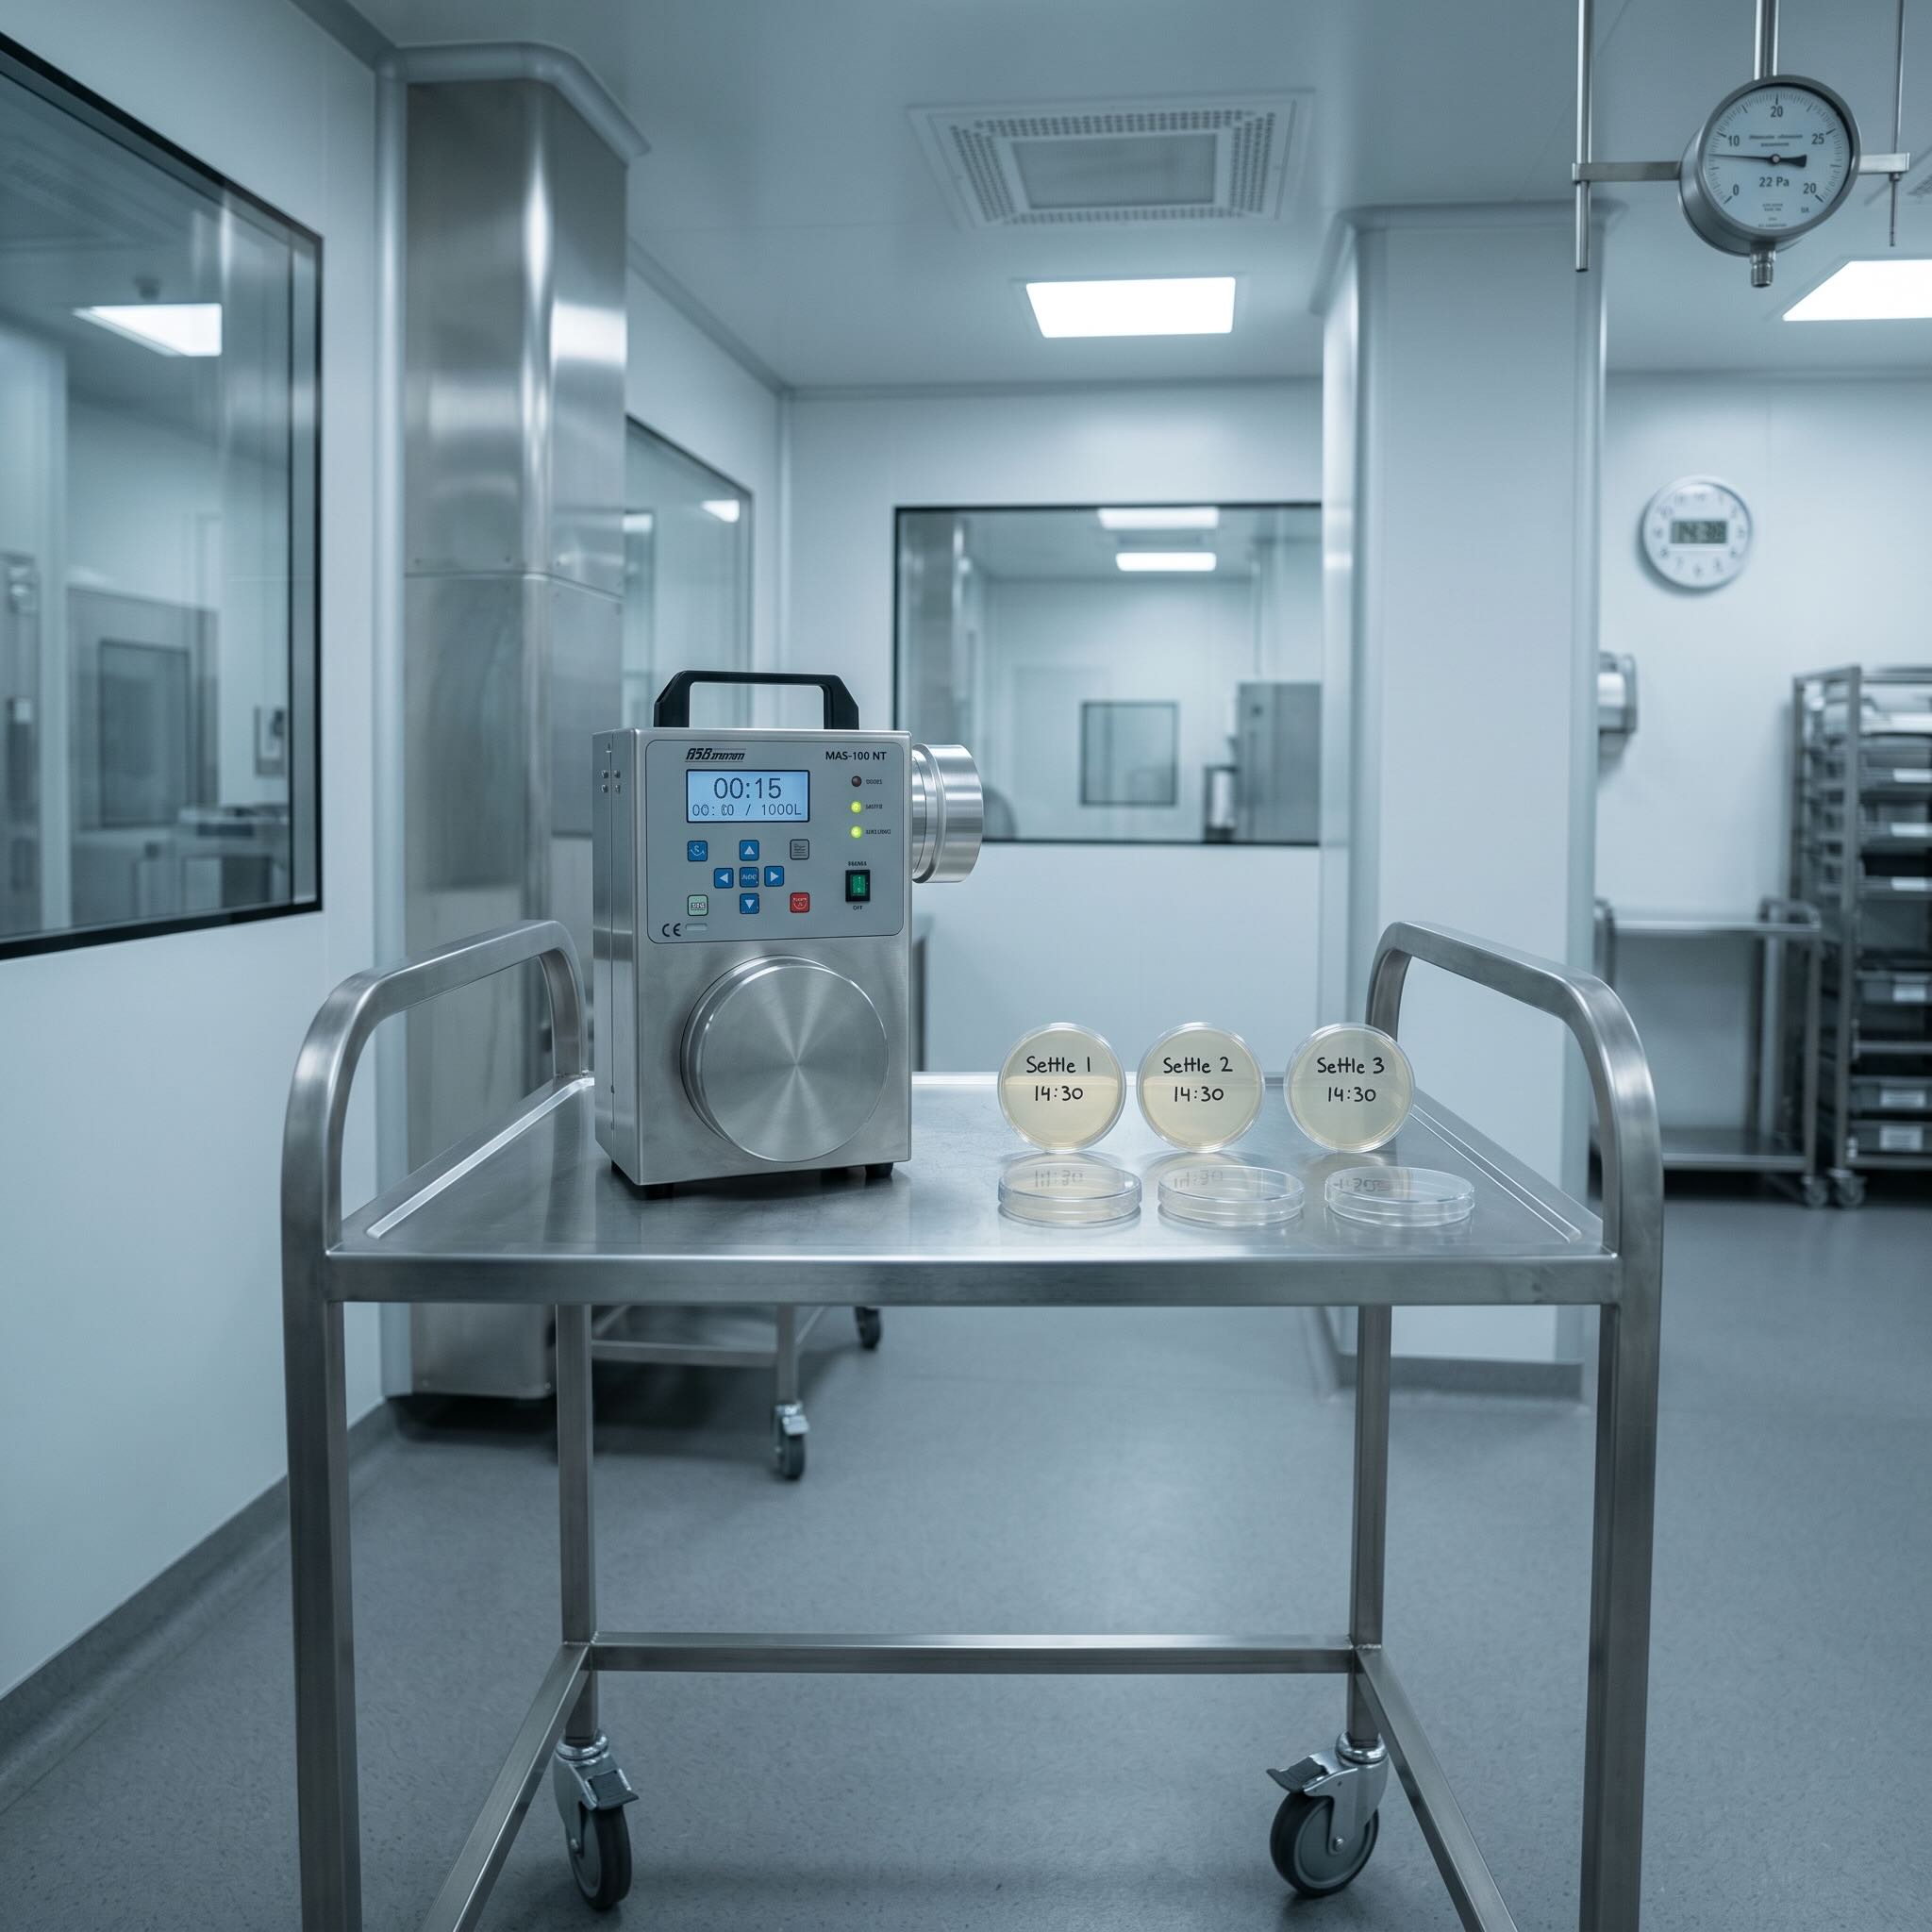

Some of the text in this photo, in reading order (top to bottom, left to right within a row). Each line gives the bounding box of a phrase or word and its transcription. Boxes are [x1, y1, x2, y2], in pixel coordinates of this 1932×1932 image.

[1770, 106, 1783, 118] 20
[1728, 135, 1740, 146] 10
[1811, 133, 1824, 144] 25
[1758, 176, 1790, 187] 22 Pa
[1732, 184, 1740, 196] 0
[1803, 183, 1816, 194] 20
[825, 751, 887, 760] MAS-100 NT
[713, 777, 782, 799] 00:15
[761, 803, 802, 816] 1000L
[1026, 1056, 1075, 1074] Settle
[1163, 1056, 1234, 1074] Settle 2
[1317, 1057, 1385, 1074] Settle 3
[1035, 1085, 1083, 1102] 14:30
[1174, 1086, 1224, 1102] 14:30
[1327, 1087, 1376, 1103] 14:30
